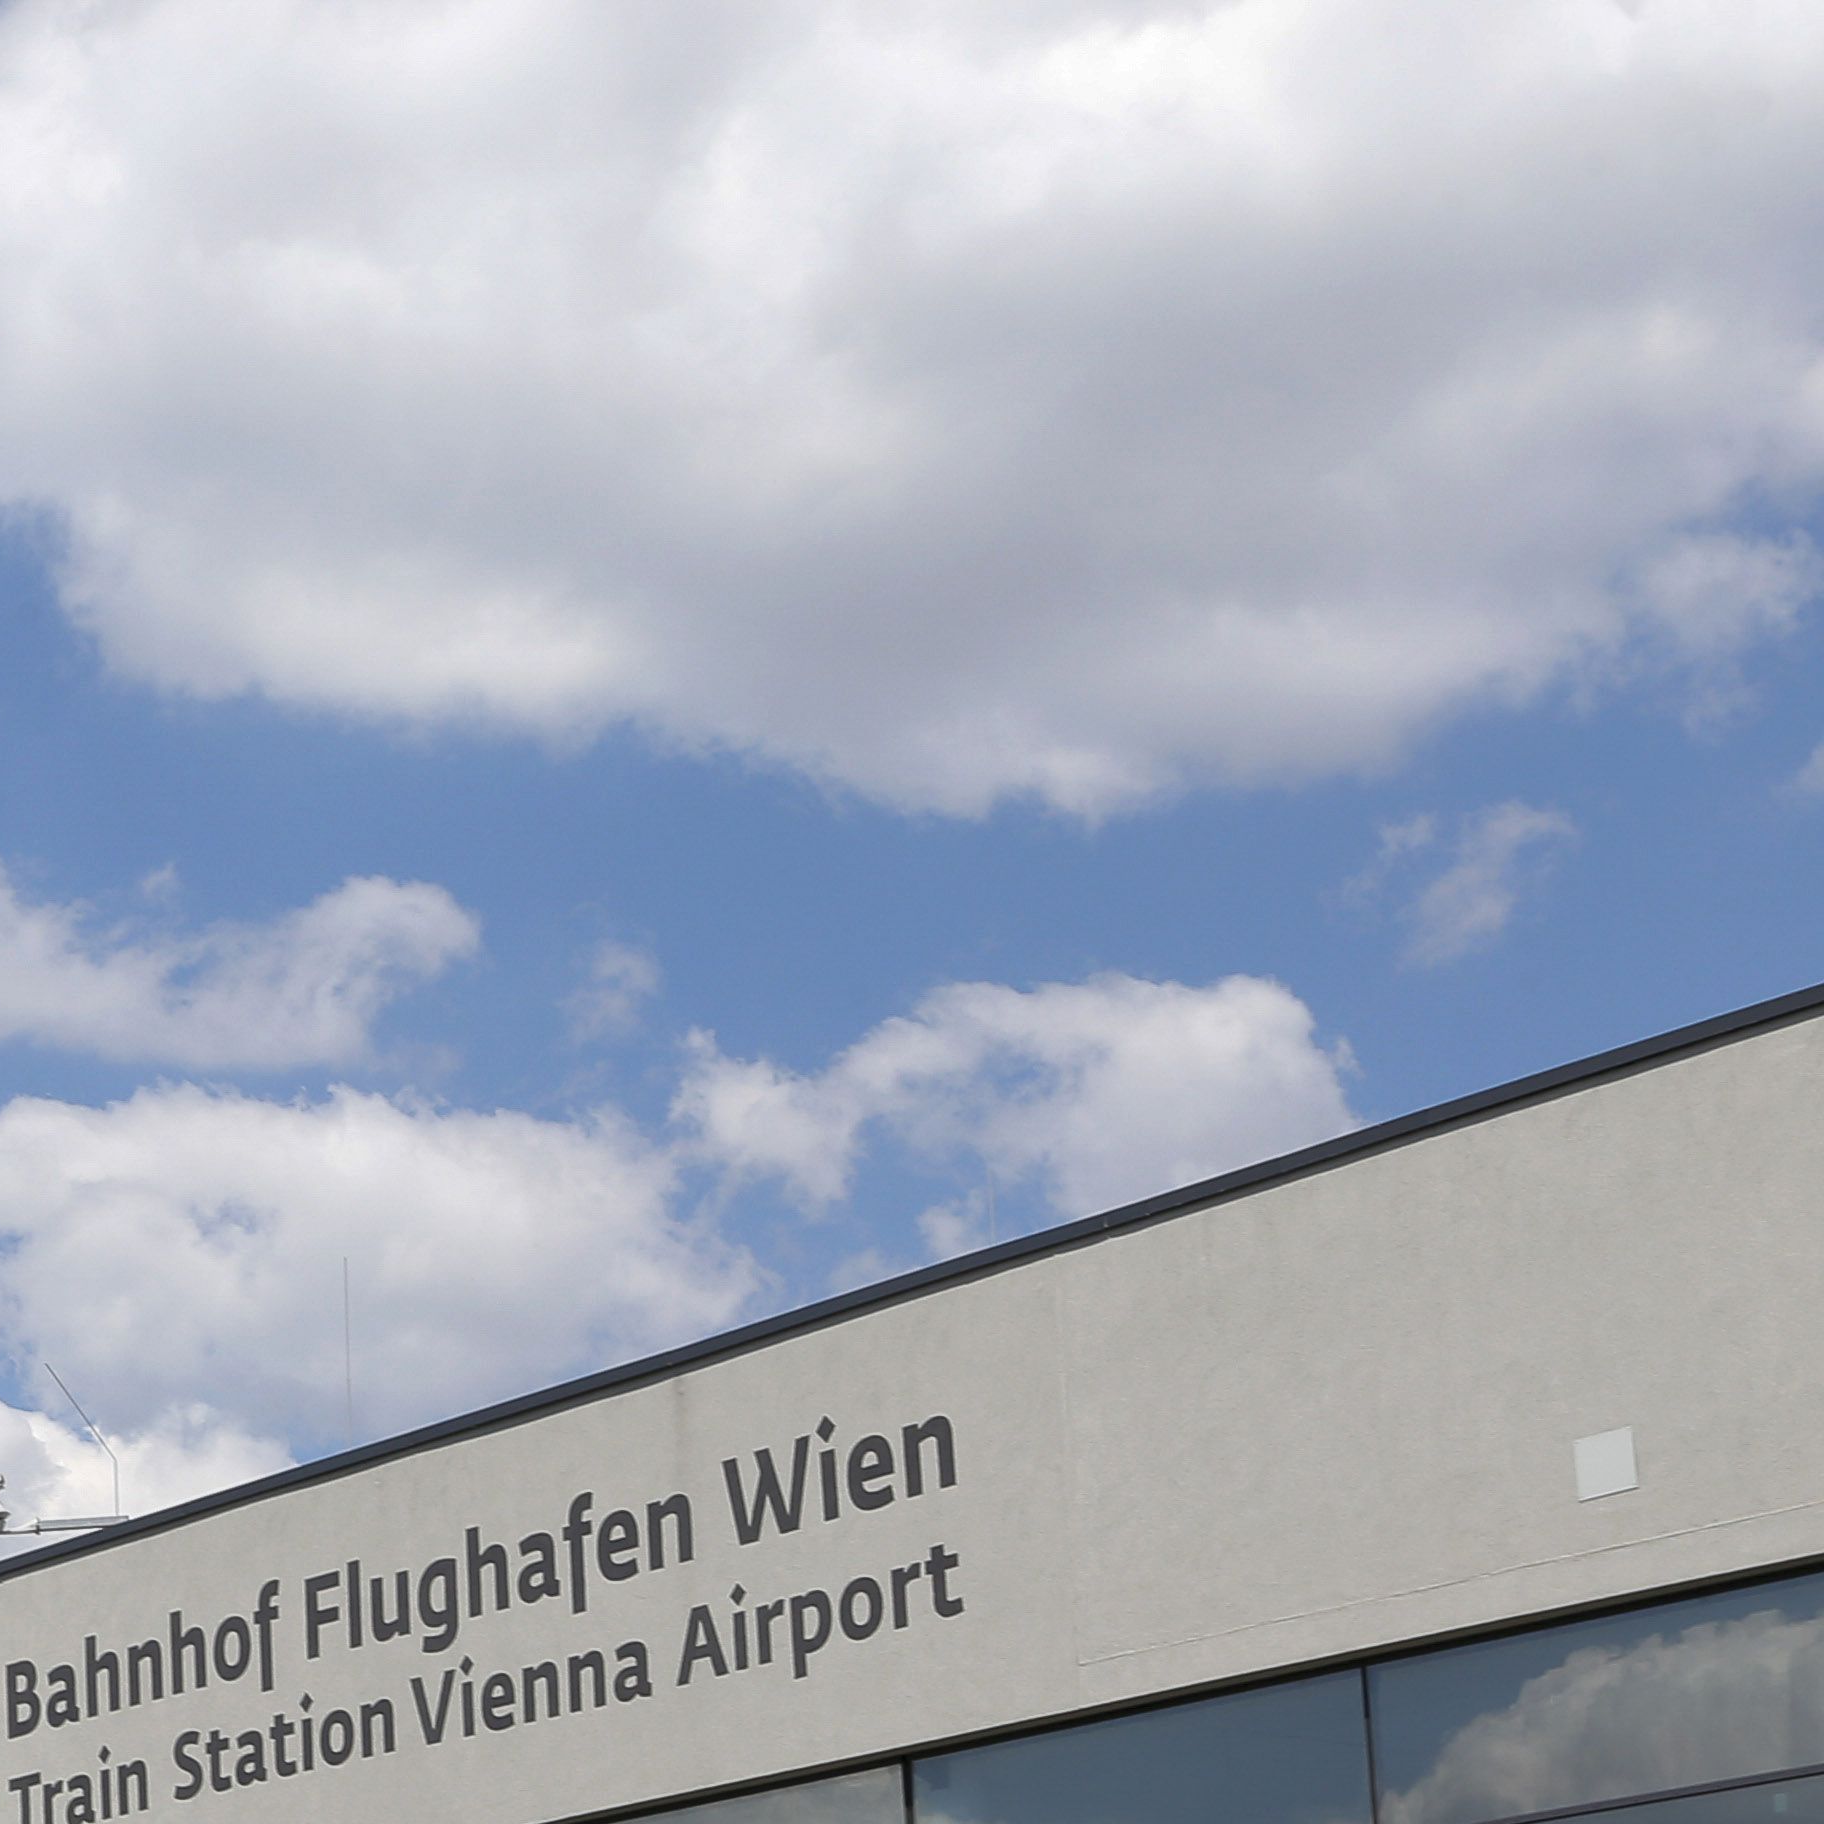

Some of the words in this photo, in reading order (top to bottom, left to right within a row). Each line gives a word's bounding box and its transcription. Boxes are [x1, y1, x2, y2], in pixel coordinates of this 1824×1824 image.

[5, 1579, 280, 1740] Bahnhof
[304, 1490, 694, 1660] Flughafen
[721, 1414, 958, 1546] Wien
[172, 1692, 396, 1801] Station
[410, 1641, 652, 1746] Vienna
[676, 1543, 965, 1686] Airport
